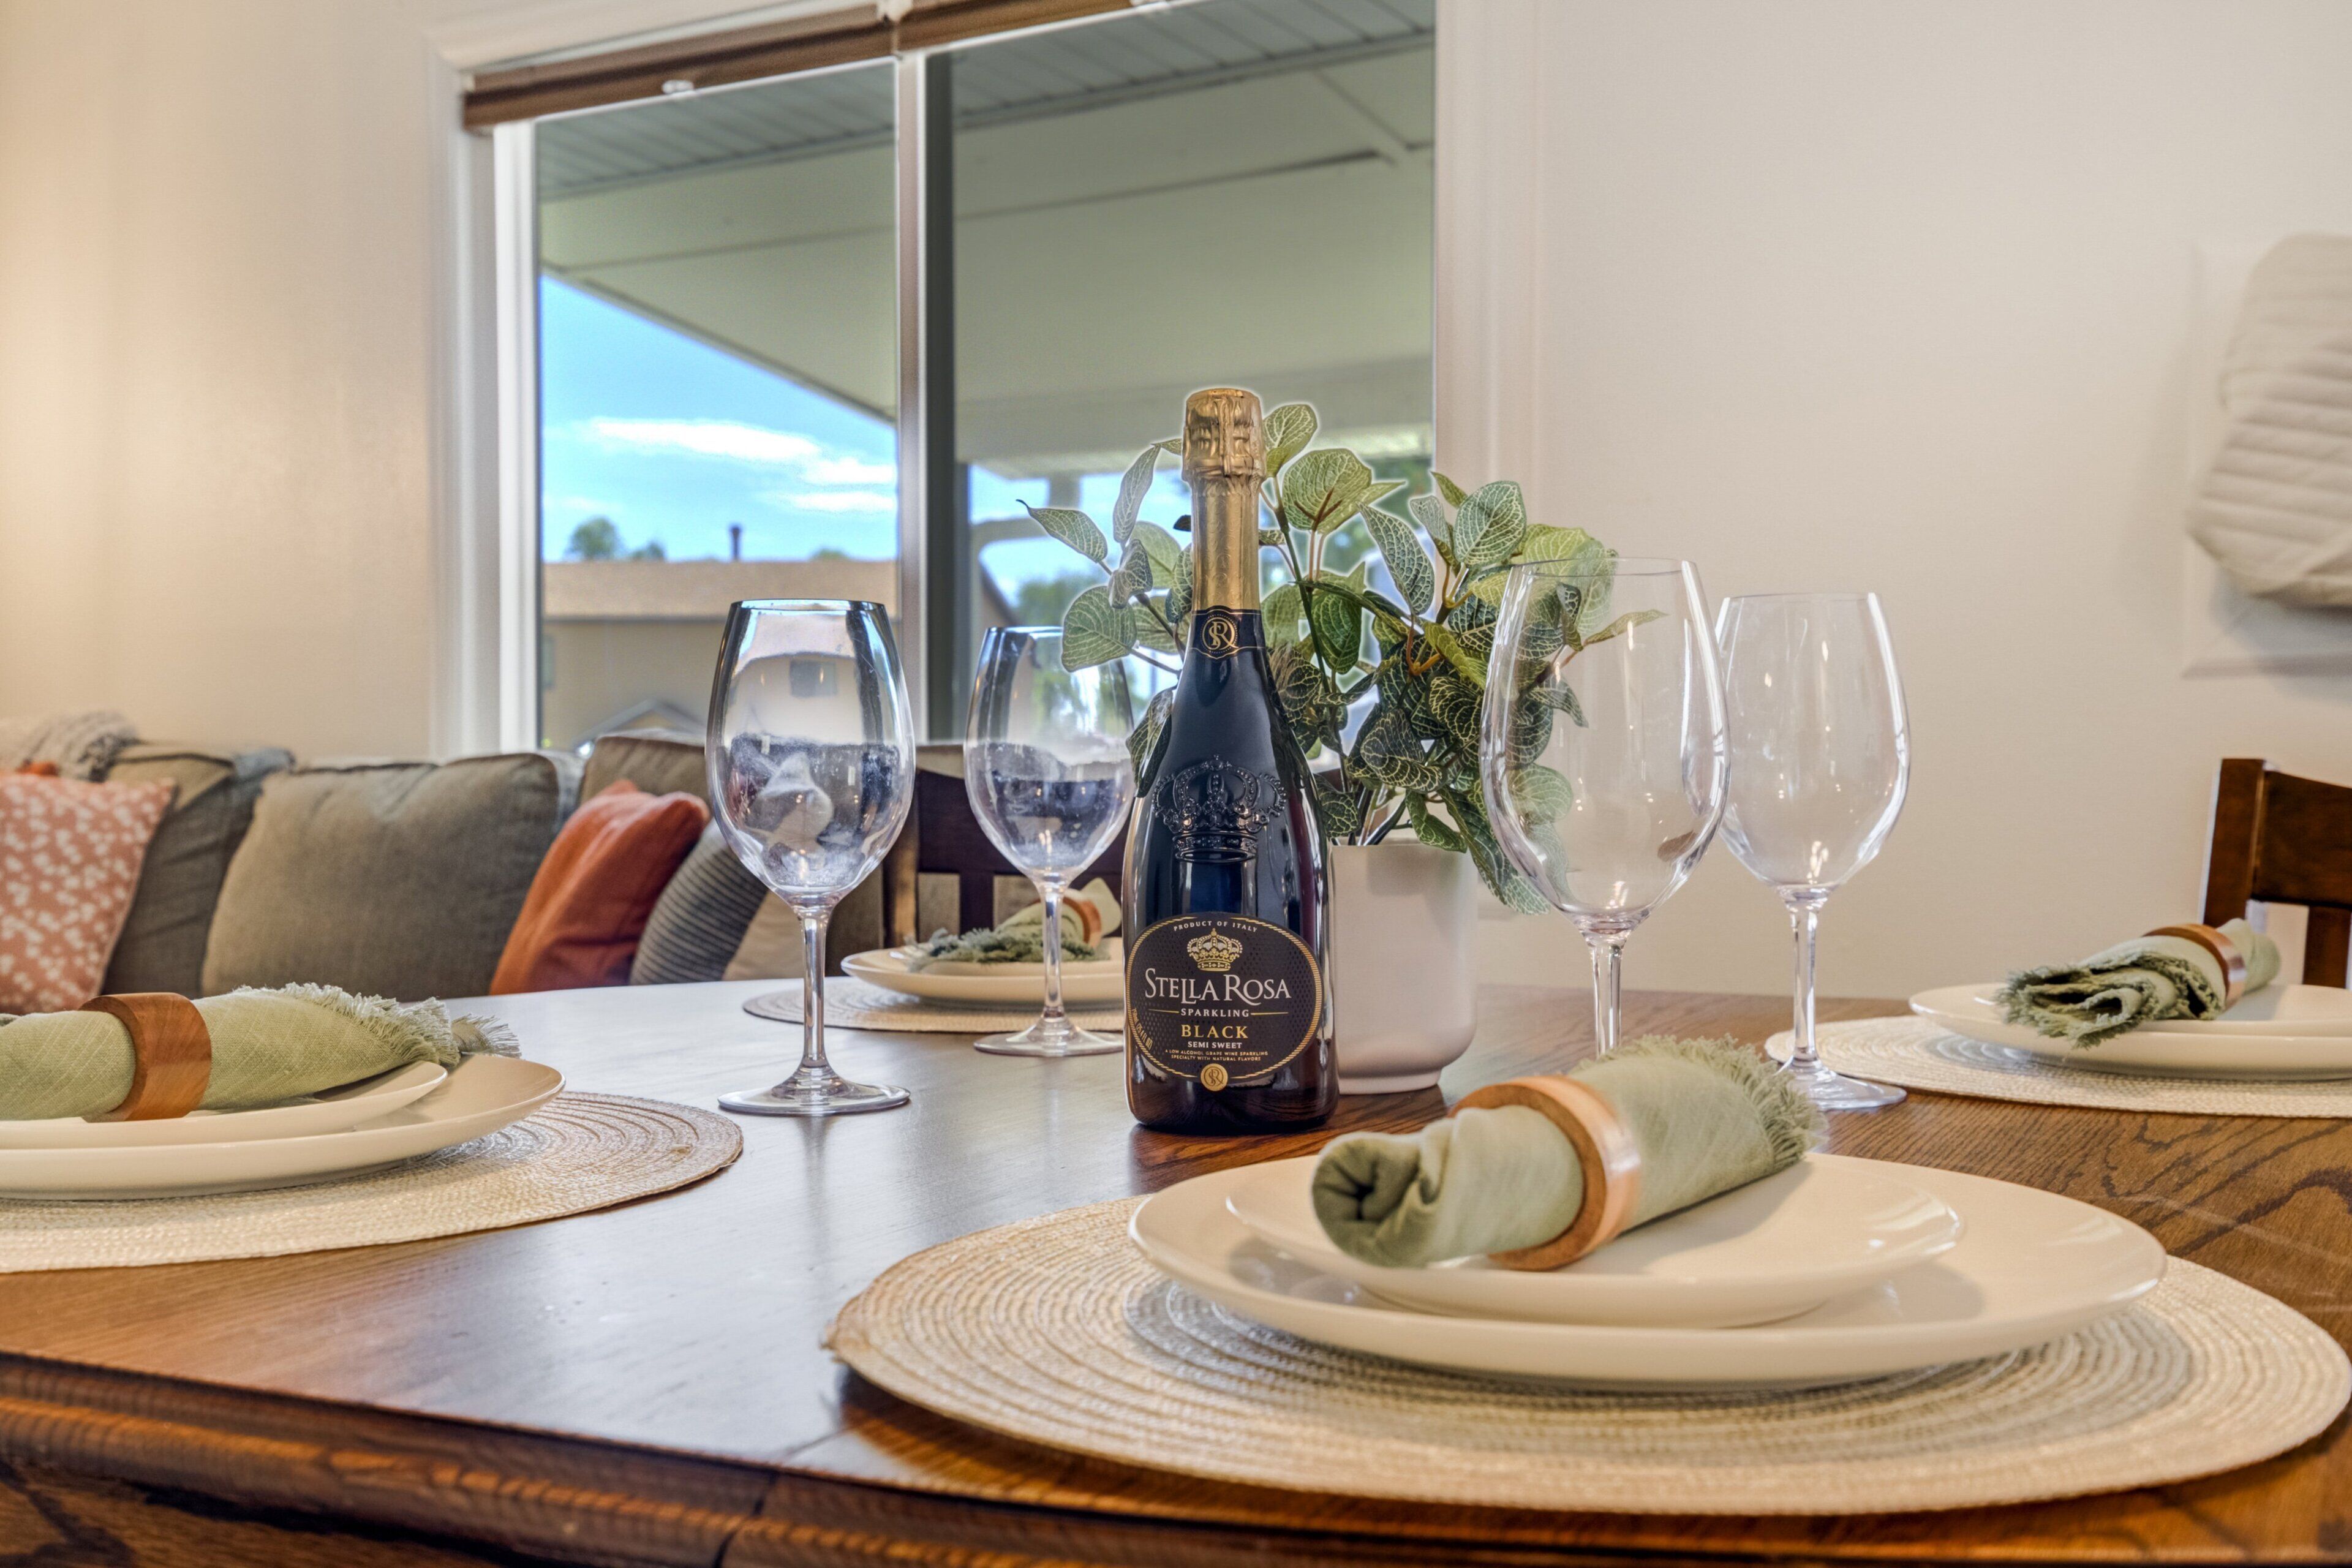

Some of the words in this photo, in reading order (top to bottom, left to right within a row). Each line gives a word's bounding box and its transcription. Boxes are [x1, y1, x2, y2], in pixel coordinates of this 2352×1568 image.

[1174, 921, 1212, 932] PRODUCT
[1232, 922, 1257, 933] ITALY
[1145, 968, 1220, 1005] STELLA
[1223, 974, 1292, 1006] ROSA
[1181, 1008, 1250, 1017] SPARKLING
[1181, 1024, 1249, 1039] BLACK
